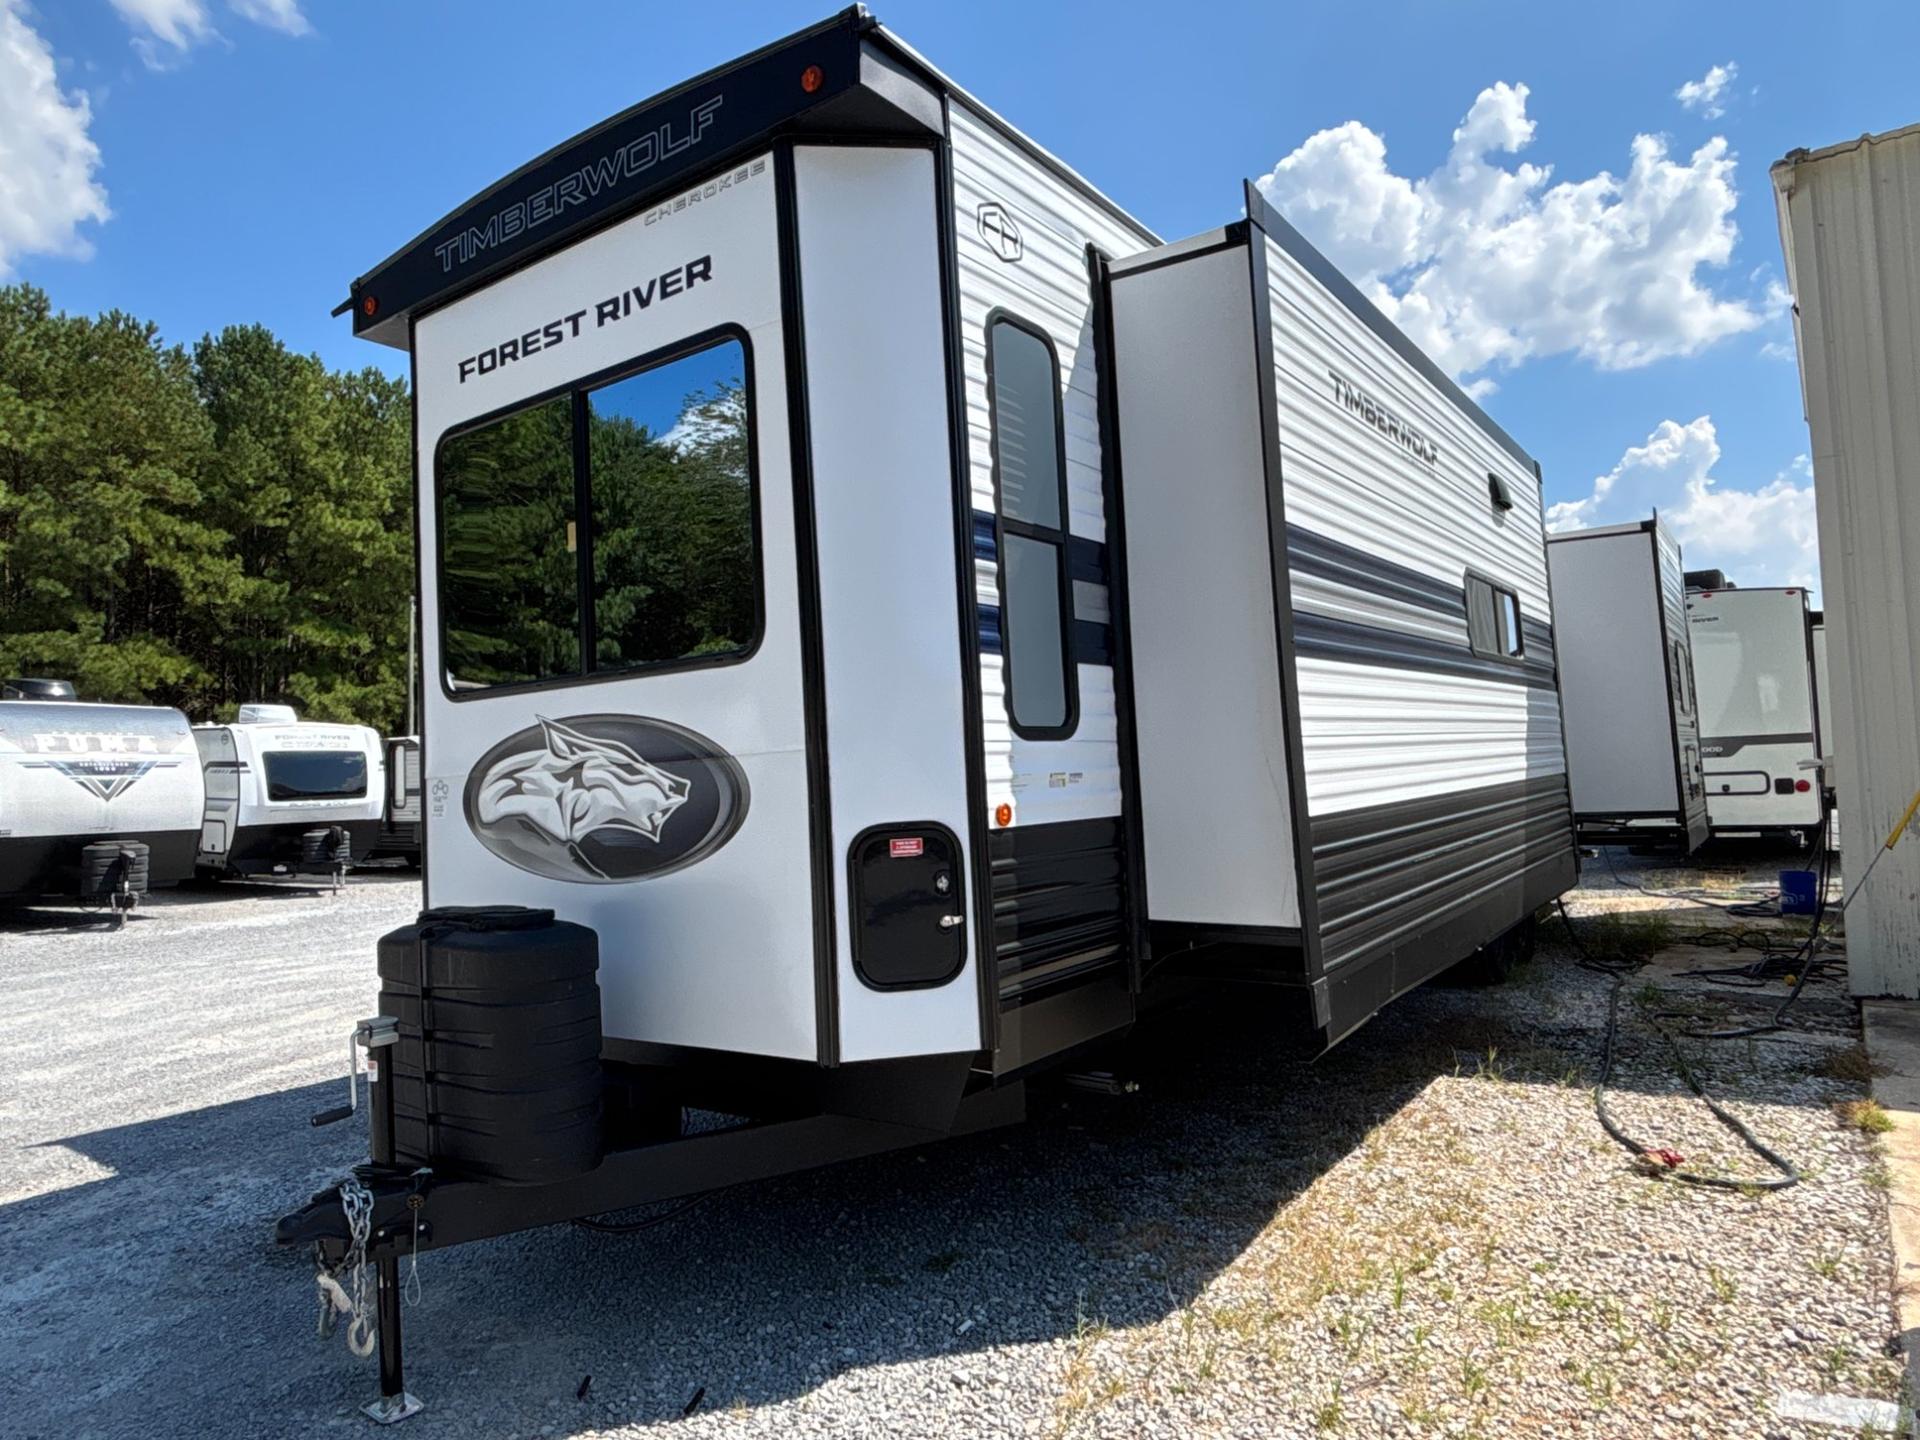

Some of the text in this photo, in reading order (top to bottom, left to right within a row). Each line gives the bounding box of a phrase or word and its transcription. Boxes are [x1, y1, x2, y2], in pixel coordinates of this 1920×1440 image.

[434, 94, 723, 273] TIMBERWOLF
[644, 159, 766, 227] CHEROKEE
[458, 254, 713, 384] FOREST RIVER
[1327, 369, 1438, 466] TIMBERWOLF
